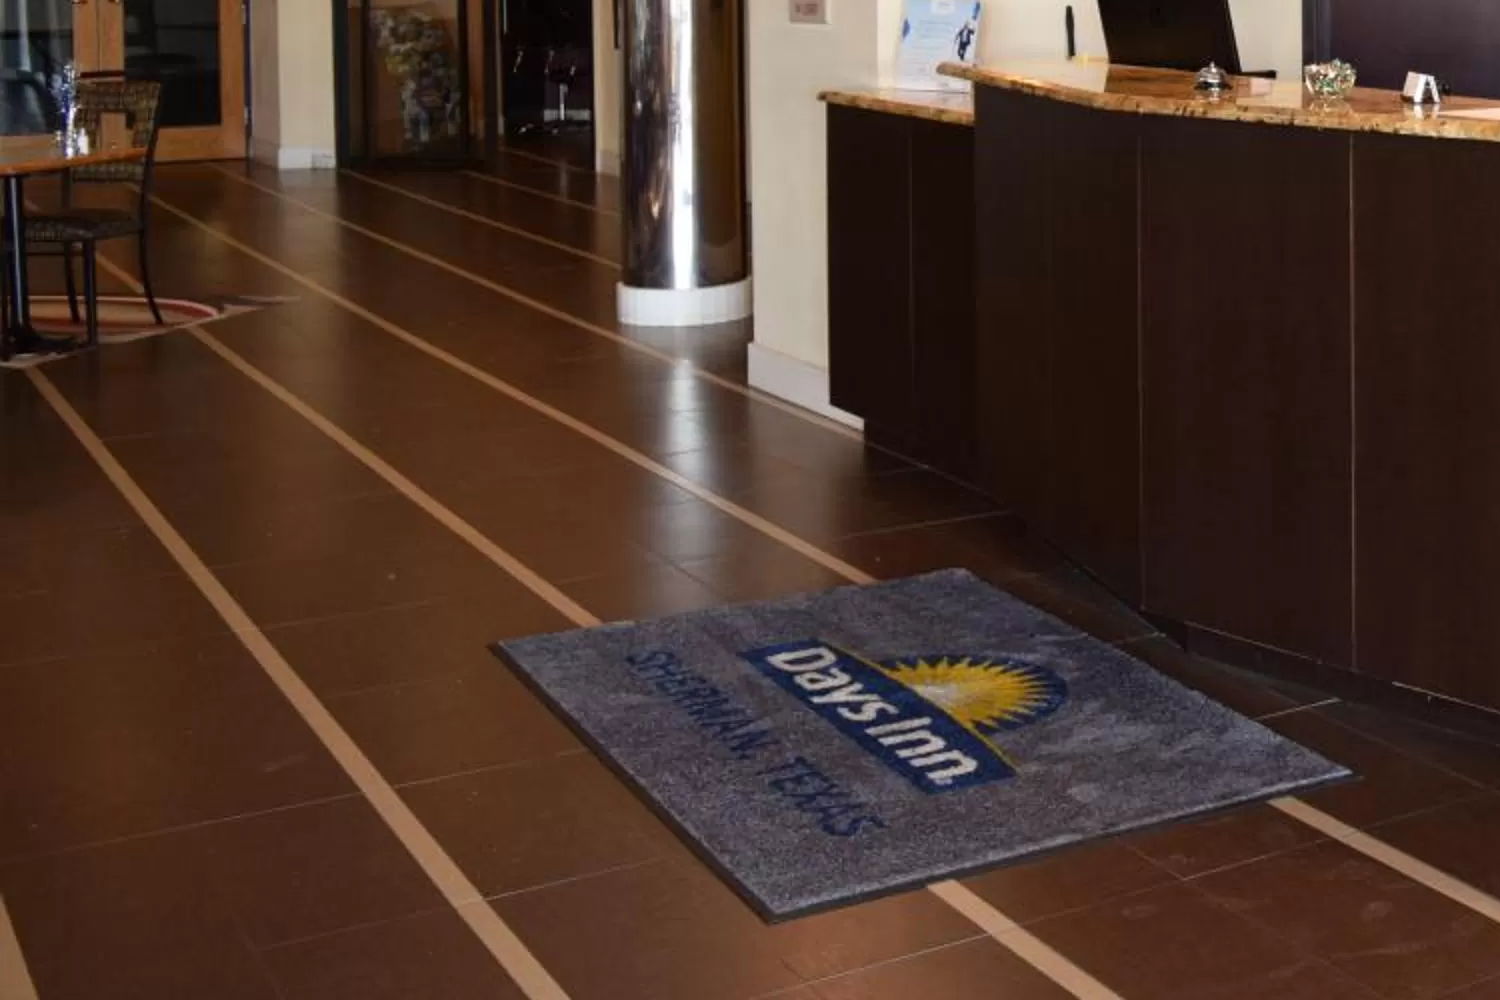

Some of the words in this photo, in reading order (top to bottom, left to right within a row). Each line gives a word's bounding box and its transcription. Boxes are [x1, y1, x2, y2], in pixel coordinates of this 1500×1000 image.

[764, 646, 899, 722] Days
[864, 715, 979, 783] Inn
[754, 755, 888, 837] TEXAS
